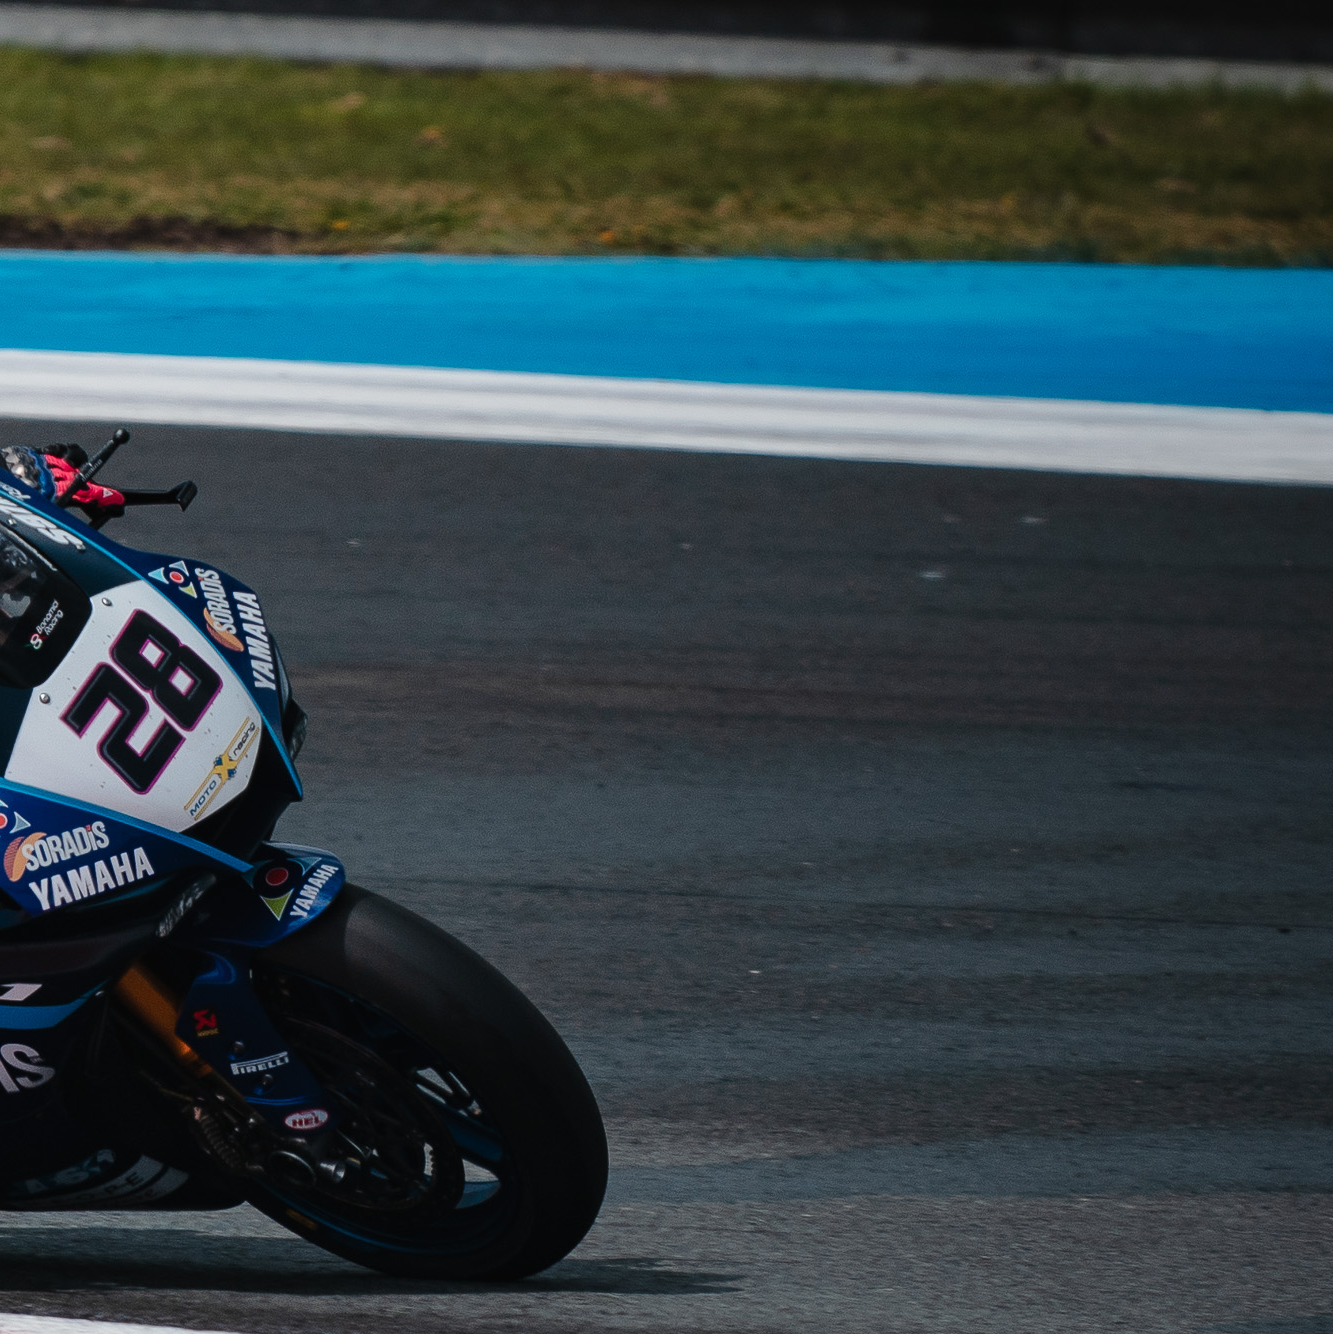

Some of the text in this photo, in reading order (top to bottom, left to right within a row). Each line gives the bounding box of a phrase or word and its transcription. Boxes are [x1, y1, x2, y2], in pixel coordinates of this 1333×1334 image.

[233, 590, 277, 691] YAMAHA
[59, 608, 224, 795] 28
[189, 780, 217, 817] MOTO
[28, 846, 155, 911] YAMAHA
[290, 863, 340, 920] YAMAHA
[230, 1051, 290, 1075] PIRELLI
[291, 1115, 321, 1128] HEL
